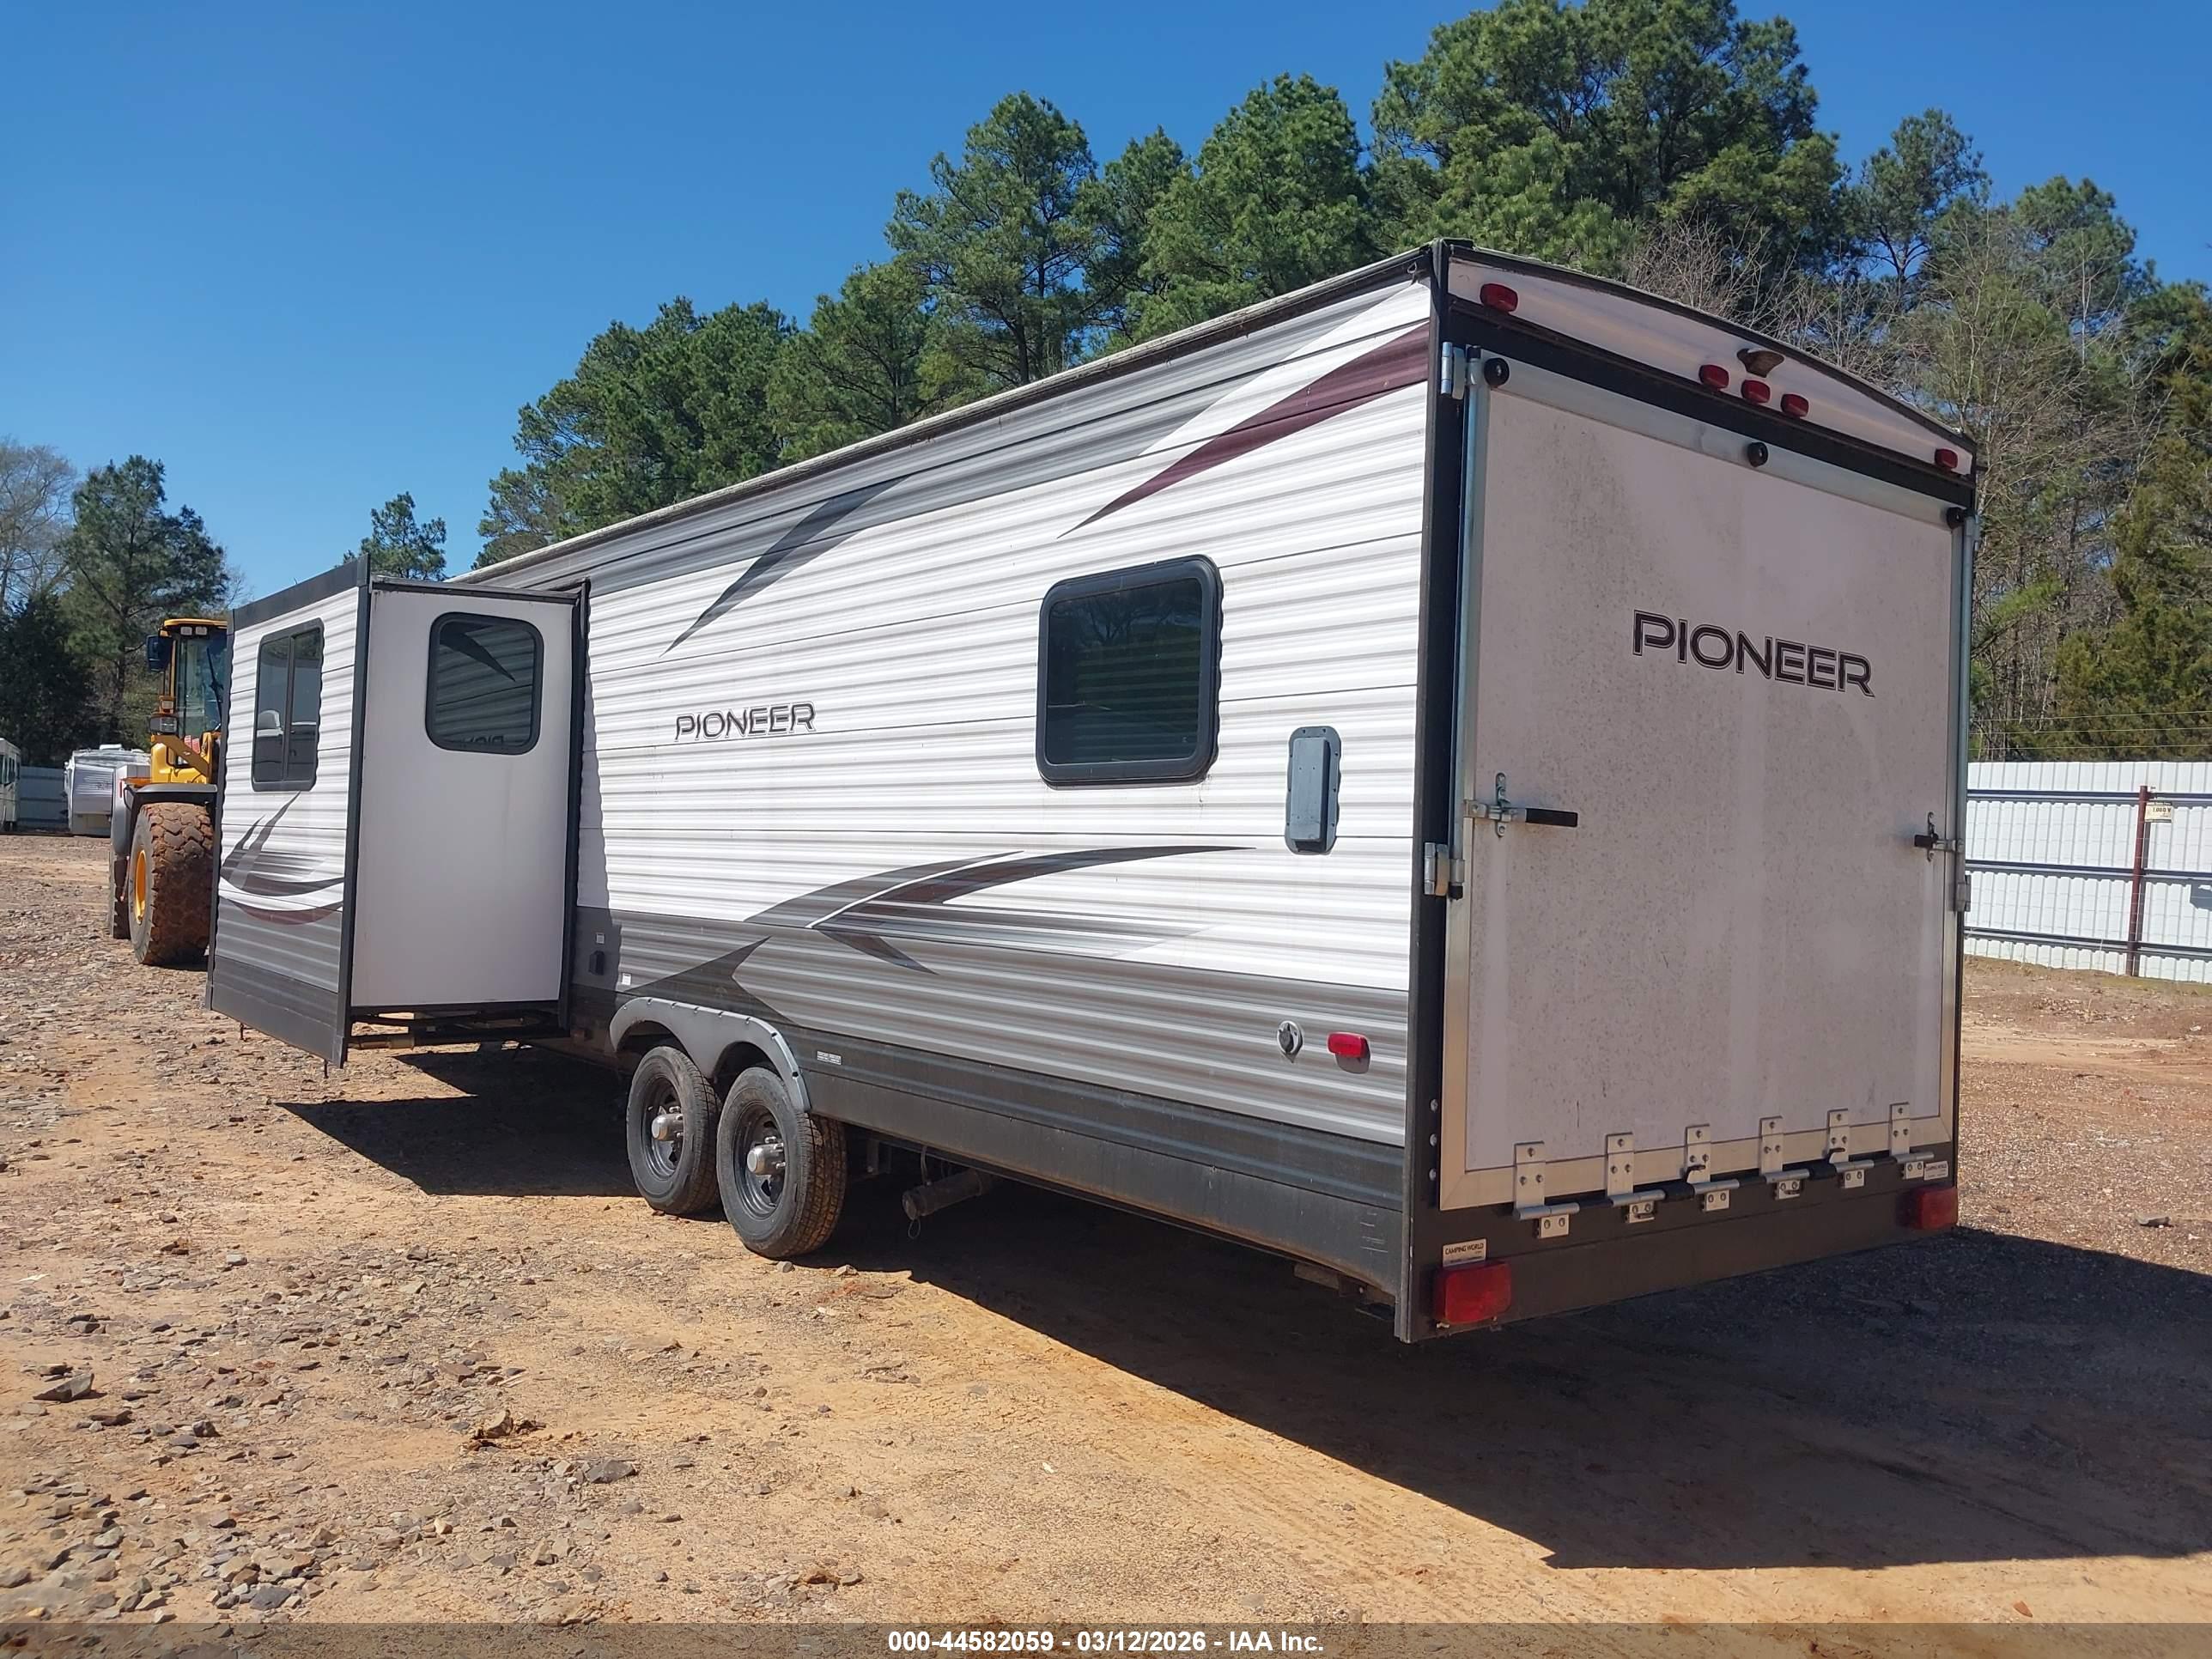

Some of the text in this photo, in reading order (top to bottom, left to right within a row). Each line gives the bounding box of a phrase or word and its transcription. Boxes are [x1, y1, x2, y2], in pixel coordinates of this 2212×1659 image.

[1632, 609, 1875, 698] PIONEER
[675, 701, 817, 742] PIONEER
[1444, 1243, 1484, 1255] CAMPING WORLD
